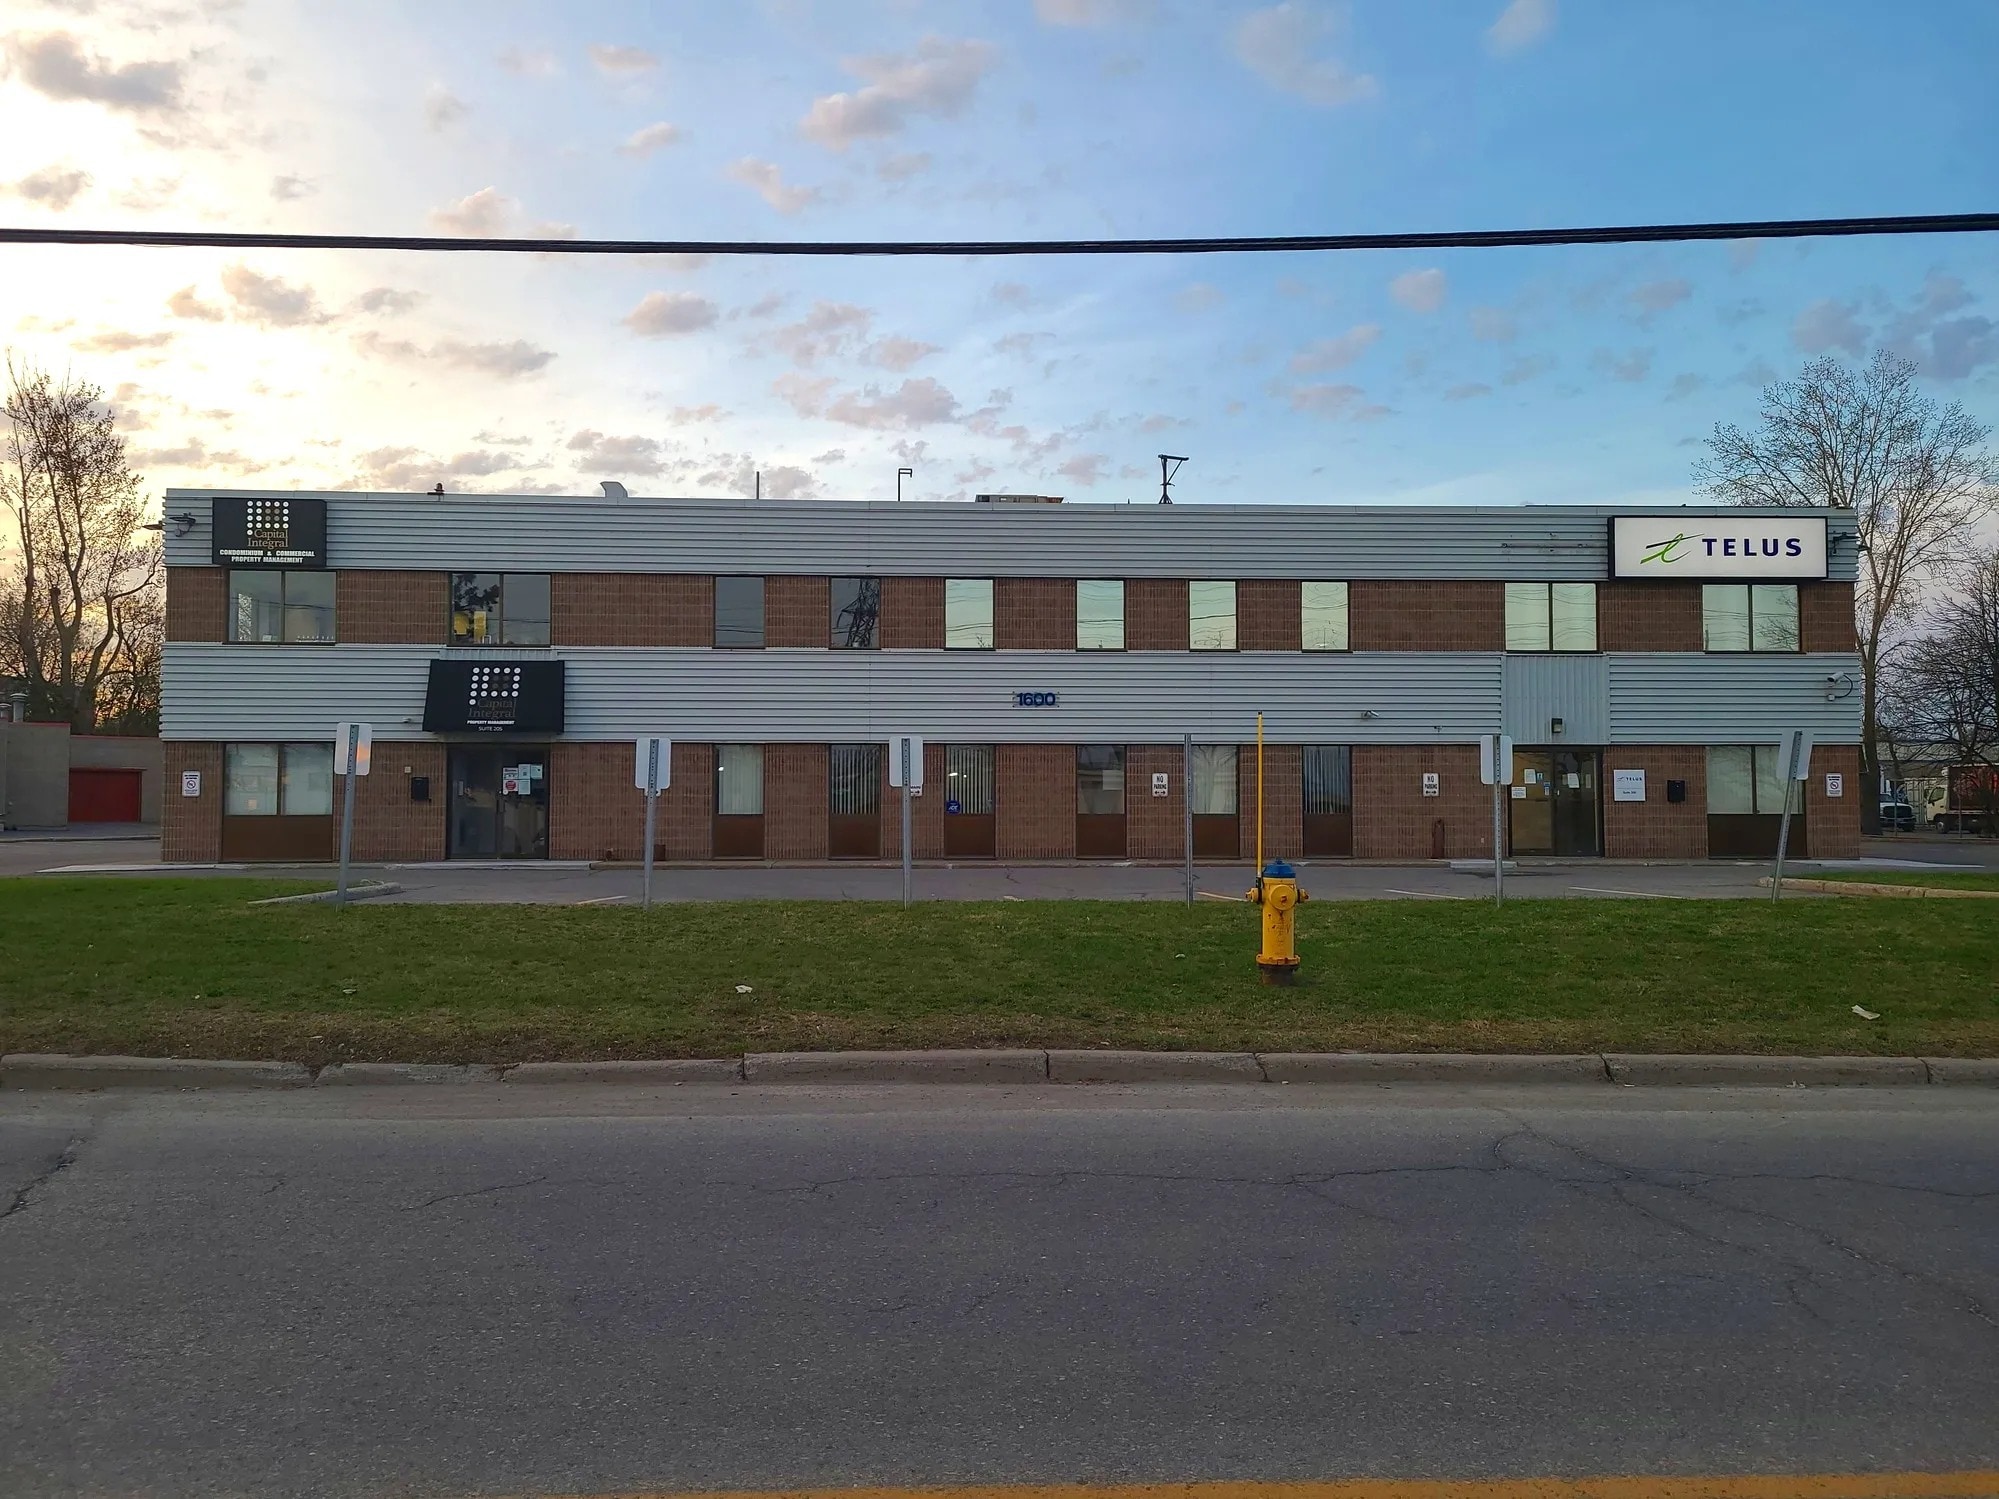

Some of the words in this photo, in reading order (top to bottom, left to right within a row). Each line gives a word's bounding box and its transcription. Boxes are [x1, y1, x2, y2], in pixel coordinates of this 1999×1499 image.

[254, 529, 288, 540] Capital
[247, 538, 288, 549] Integral
[1702, 538, 1802, 557] TELUS
[477, 698, 517, 710] Capital
[1016, 692, 1056, 706] 1600
[468, 707, 516, 719] Integral
